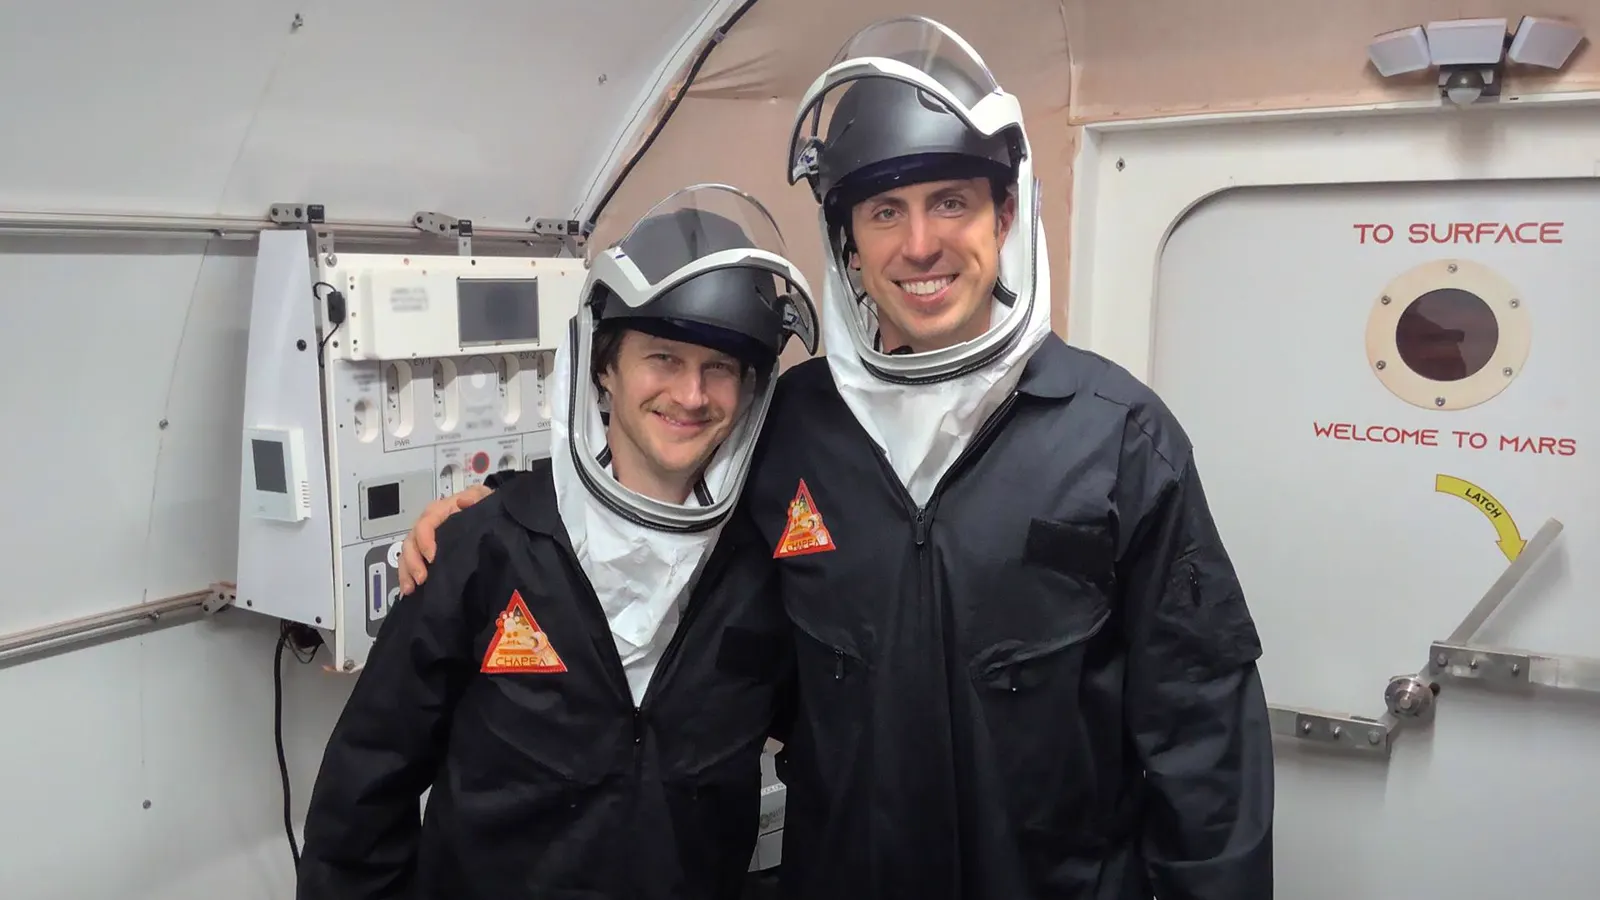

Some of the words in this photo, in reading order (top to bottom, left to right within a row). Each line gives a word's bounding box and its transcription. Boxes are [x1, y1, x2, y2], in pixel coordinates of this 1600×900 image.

[1353, 224, 1393, 244] TO
[1408, 222, 1564, 244] SURFACE
[394, 439, 410, 447] PWR
[1313, 421, 1439, 446] WELCOME
[1452, 431, 1487, 449] TO
[1499, 435, 1577, 456] MARS
[1465, 487, 1502, 518] LATCH
[786, 538, 820, 552] CHAPEA
[495, 657, 546, 667] CHAPEA
